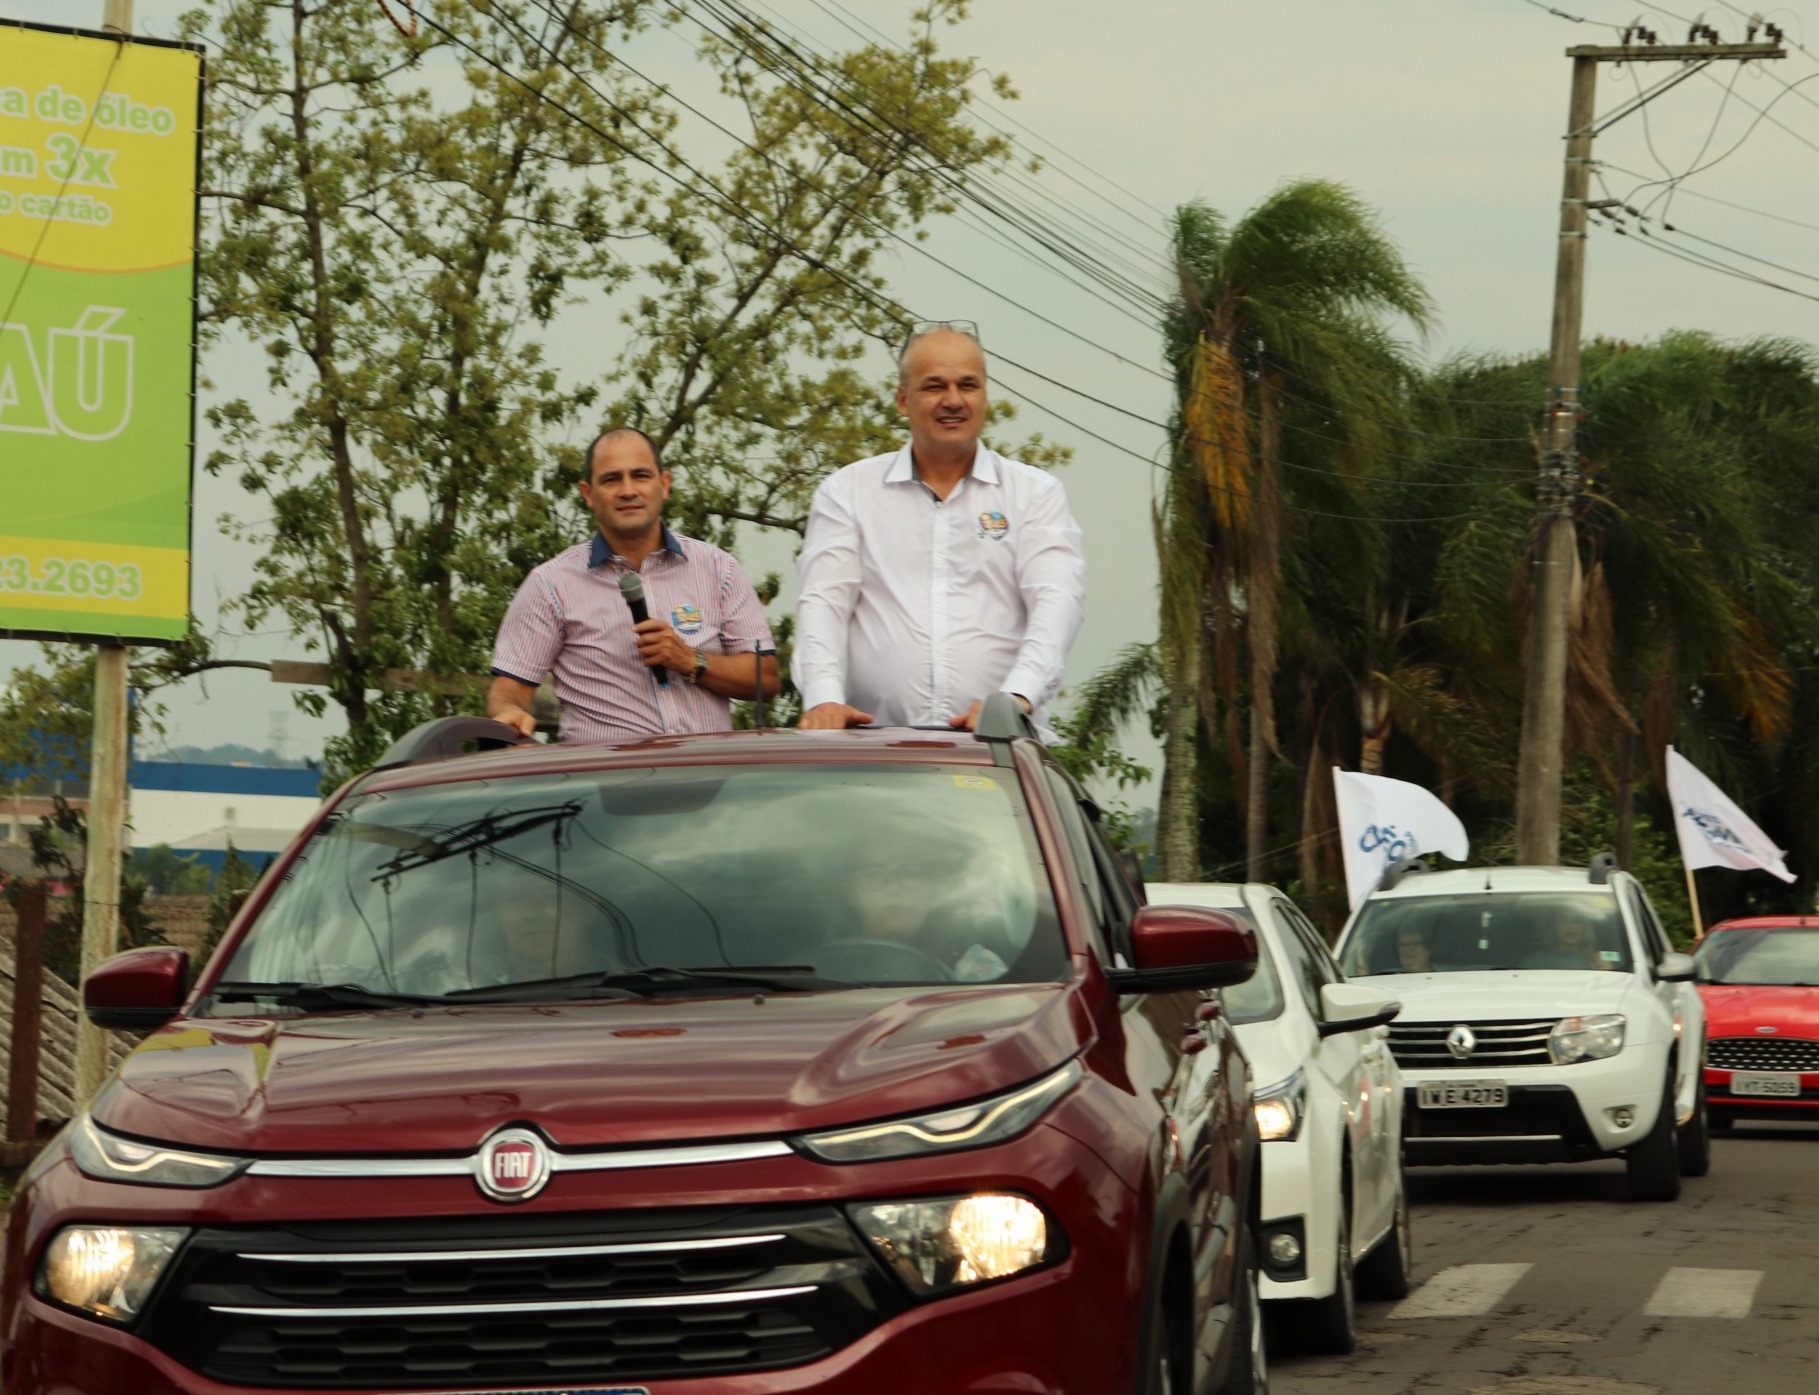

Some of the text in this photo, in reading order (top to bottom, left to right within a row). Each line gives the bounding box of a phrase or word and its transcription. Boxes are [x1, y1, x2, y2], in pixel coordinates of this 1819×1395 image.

[36, 86, 86, 124] de
[95, 92, 175, 135] óleo
[0, 132, 117, 188] m 3x
[20, 194, 112, 225] cartão
[0, 556, 143, 600] 3.2693
[495, 1151, 532, 1178] FIAT
